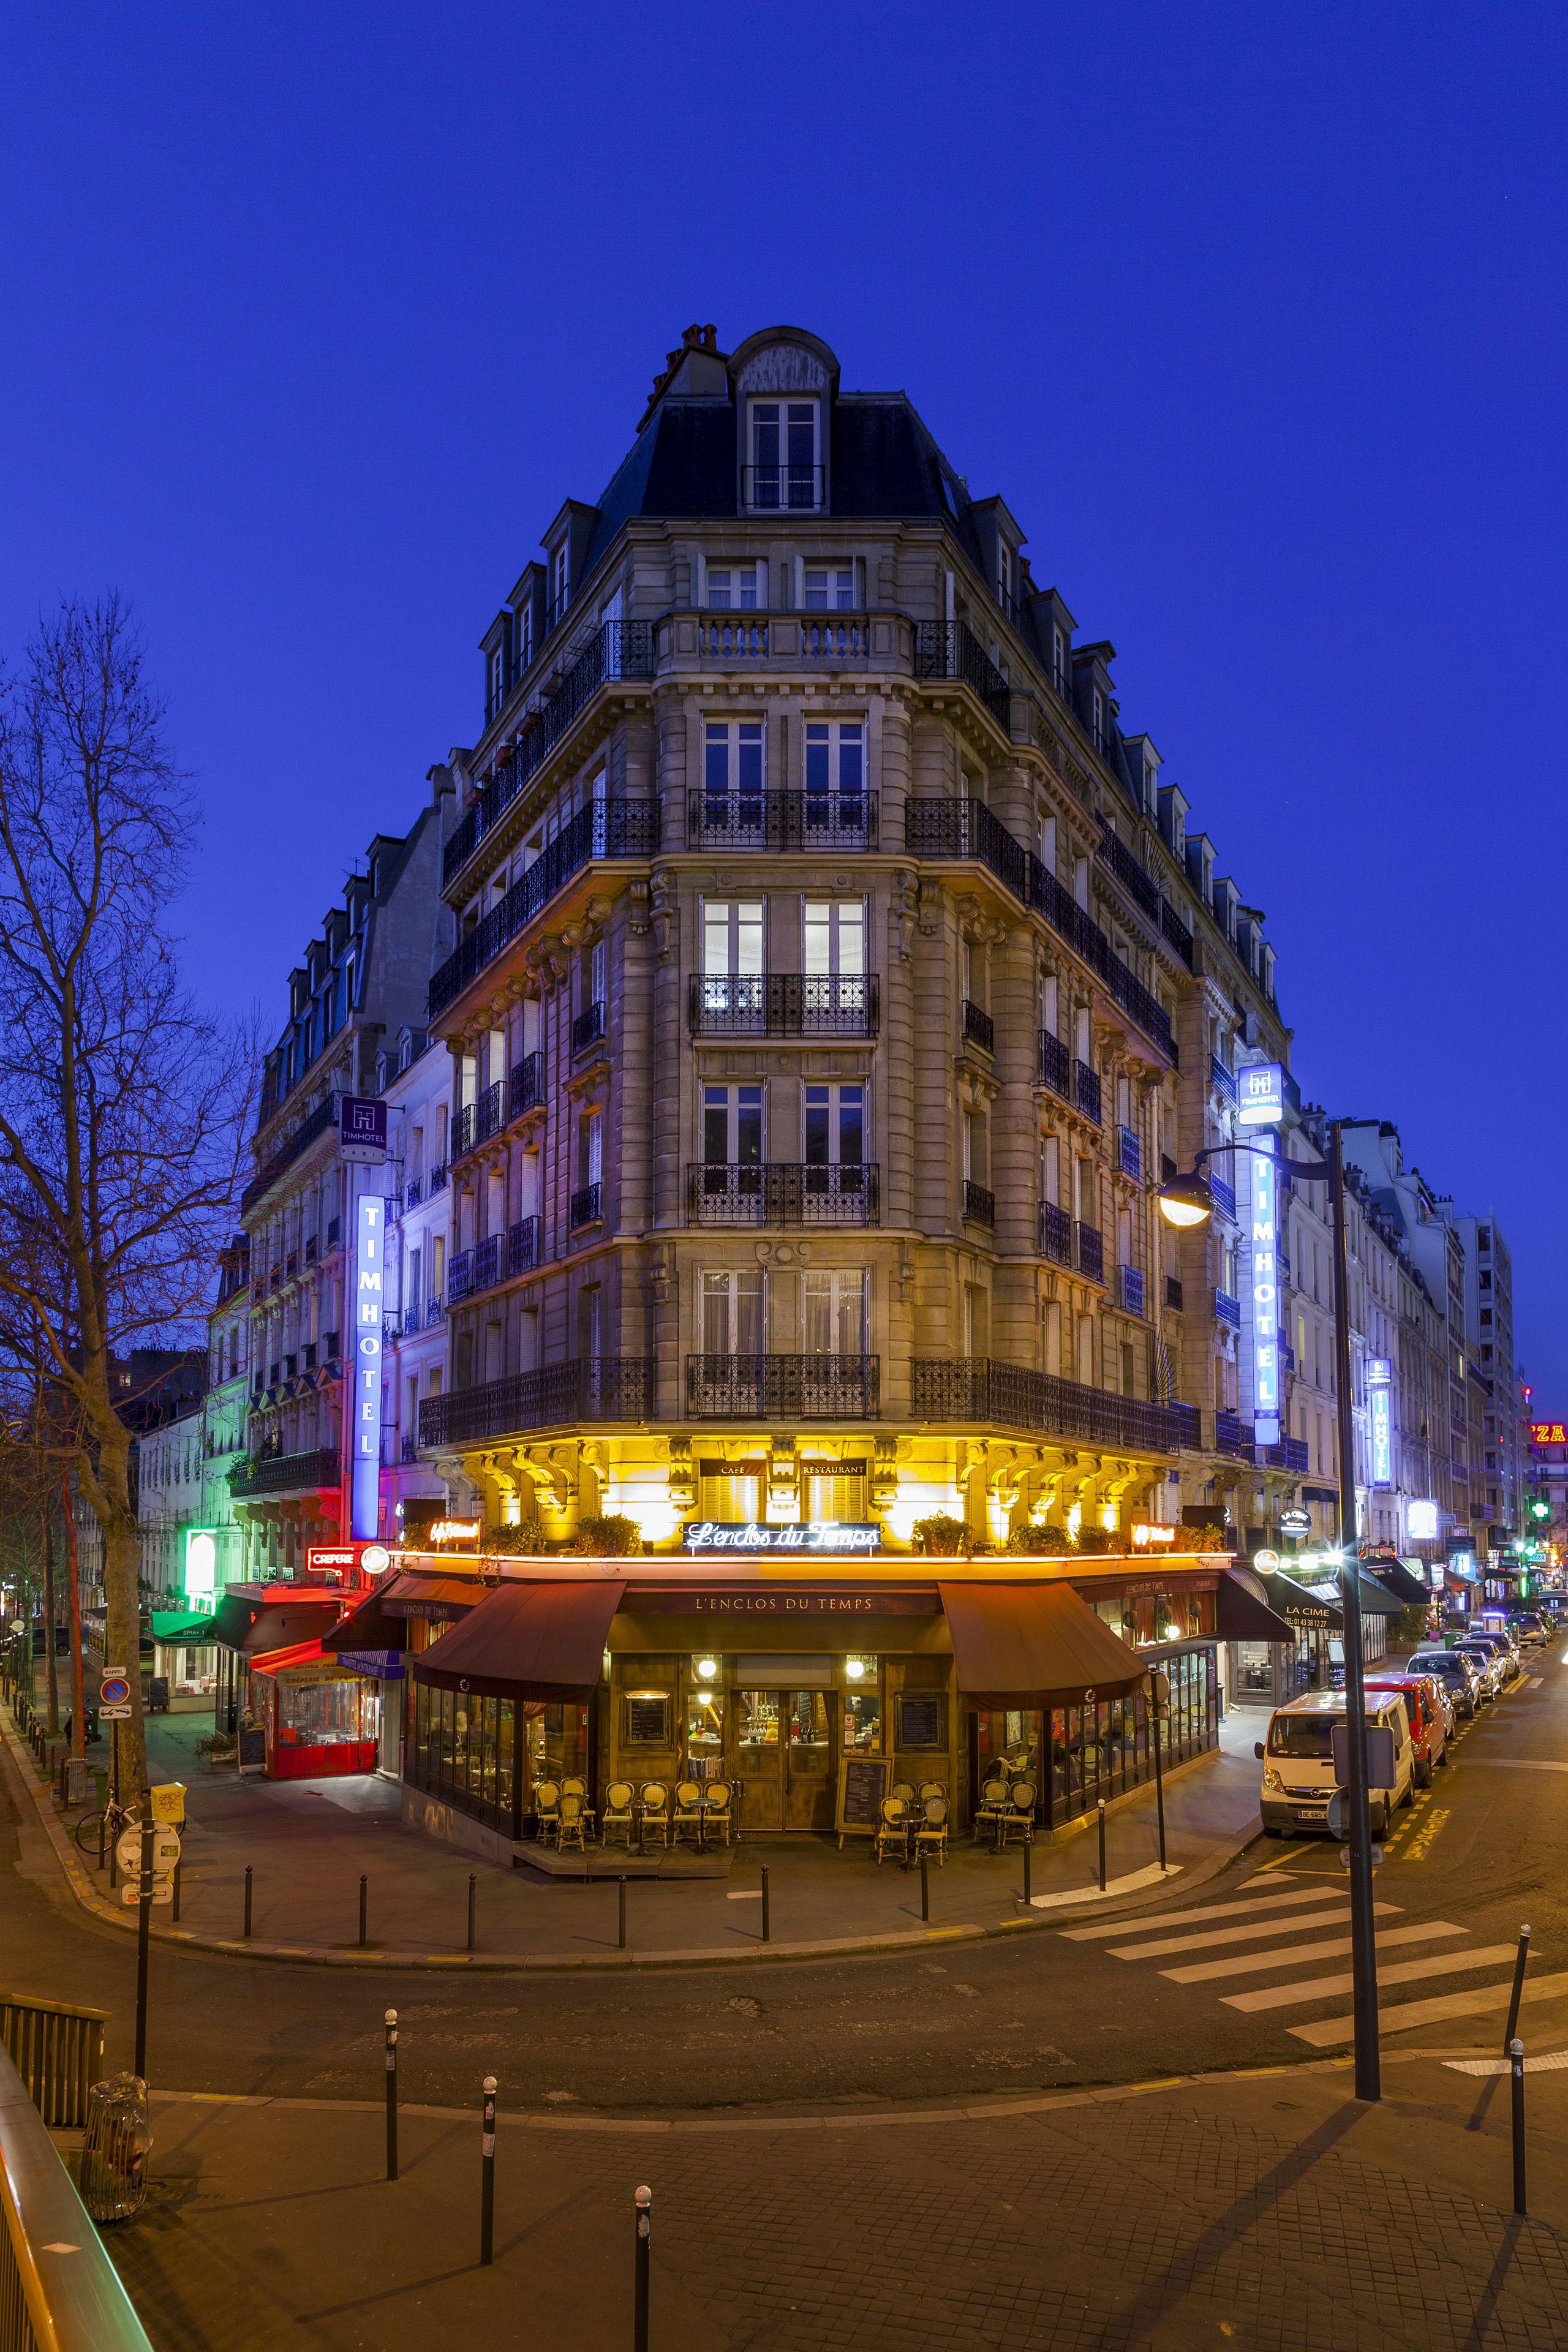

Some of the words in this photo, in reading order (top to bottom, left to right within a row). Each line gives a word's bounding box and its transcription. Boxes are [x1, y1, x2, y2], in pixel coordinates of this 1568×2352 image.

[342, 1131, 385, 1142] TIMHOTEL
[342, 1149, 385, 1158] PARIS
[1253, 1159, 1275, 1401] TIMHOTEL
[360, 1207, 382, 1454] TIMHOTEL
[1374, 1391, 1388, 1480] TIMHOTEL
[774, 1525, 804, 1546] du
[809, 1522, 878, 1550] Temps
[696, 1599, 775, 1609] L'ENCLOS
[786, 1599, 809, 1609] DU
[818, 1599, 872, 1609] TEMPS
[1286, 1606, 1300, 1615] LA
[1302, 1608, 1330, 1617] CIME
